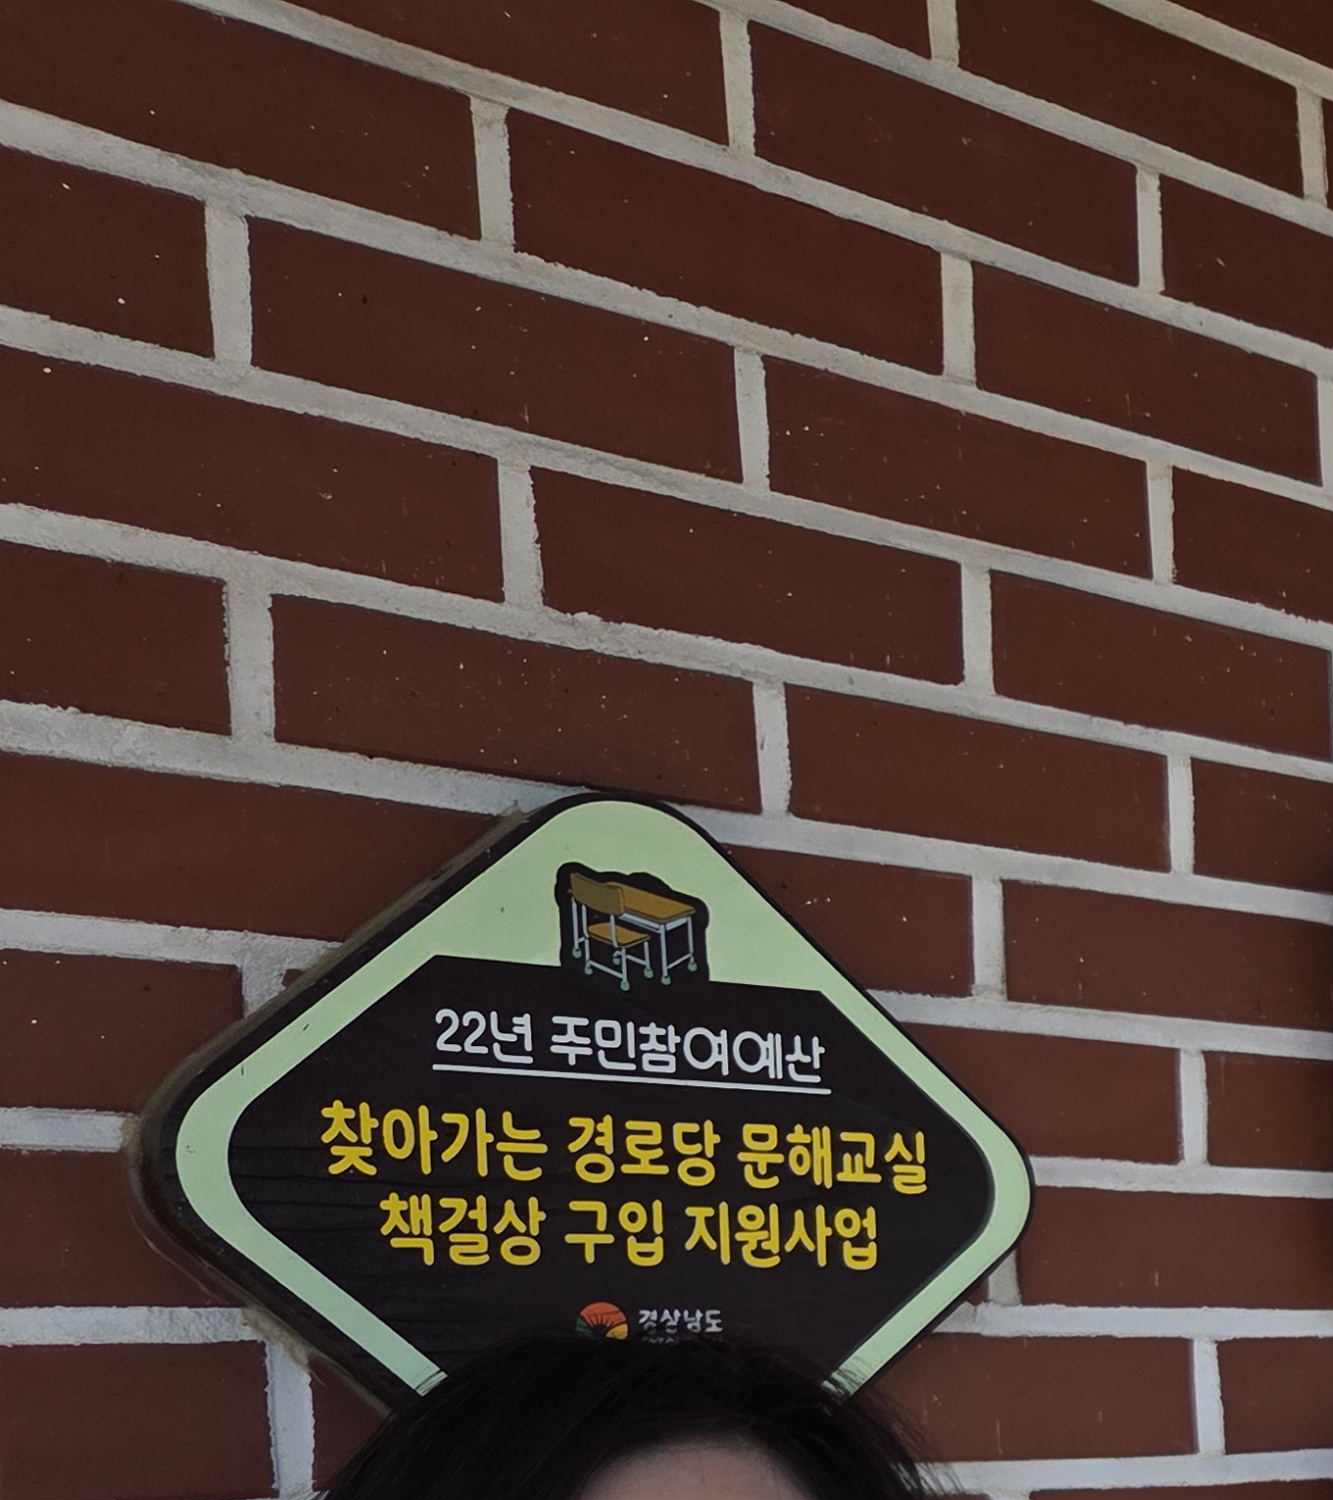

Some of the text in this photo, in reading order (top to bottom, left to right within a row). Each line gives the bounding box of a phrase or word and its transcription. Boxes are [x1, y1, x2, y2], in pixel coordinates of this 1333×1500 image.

[434, 1009, 826, 1084] 22년 주민참여예산
[321, 1099, 928, 1195] 찾아가는 경로당 문해교실
[379, 1193, 880, 1272] 책걸상 구입 지원사업
[638, 1308, 724, 1335] 경상남도
